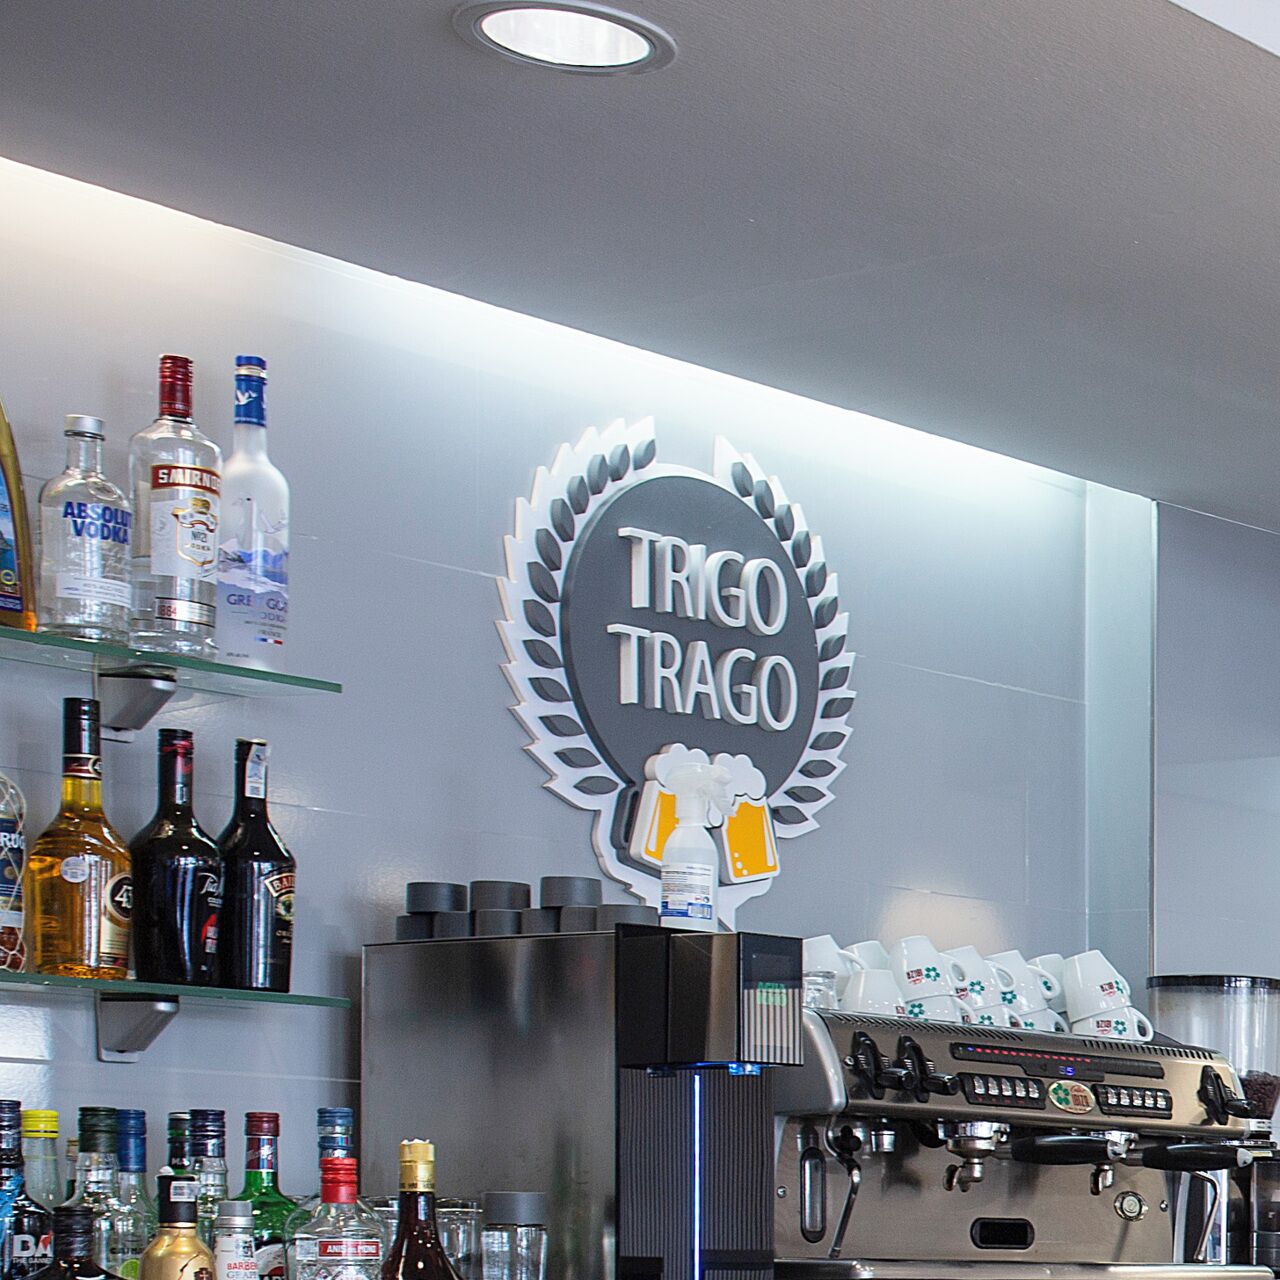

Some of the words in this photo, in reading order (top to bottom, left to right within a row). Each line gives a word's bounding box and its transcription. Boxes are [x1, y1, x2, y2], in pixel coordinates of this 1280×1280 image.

[63, 501, 133, 528] ABSOLUT
[72, 519, 130, 545] VODKA
[618, 527, 788, 636] TRIGO
[606, 623, 799, 732] TRAGO
